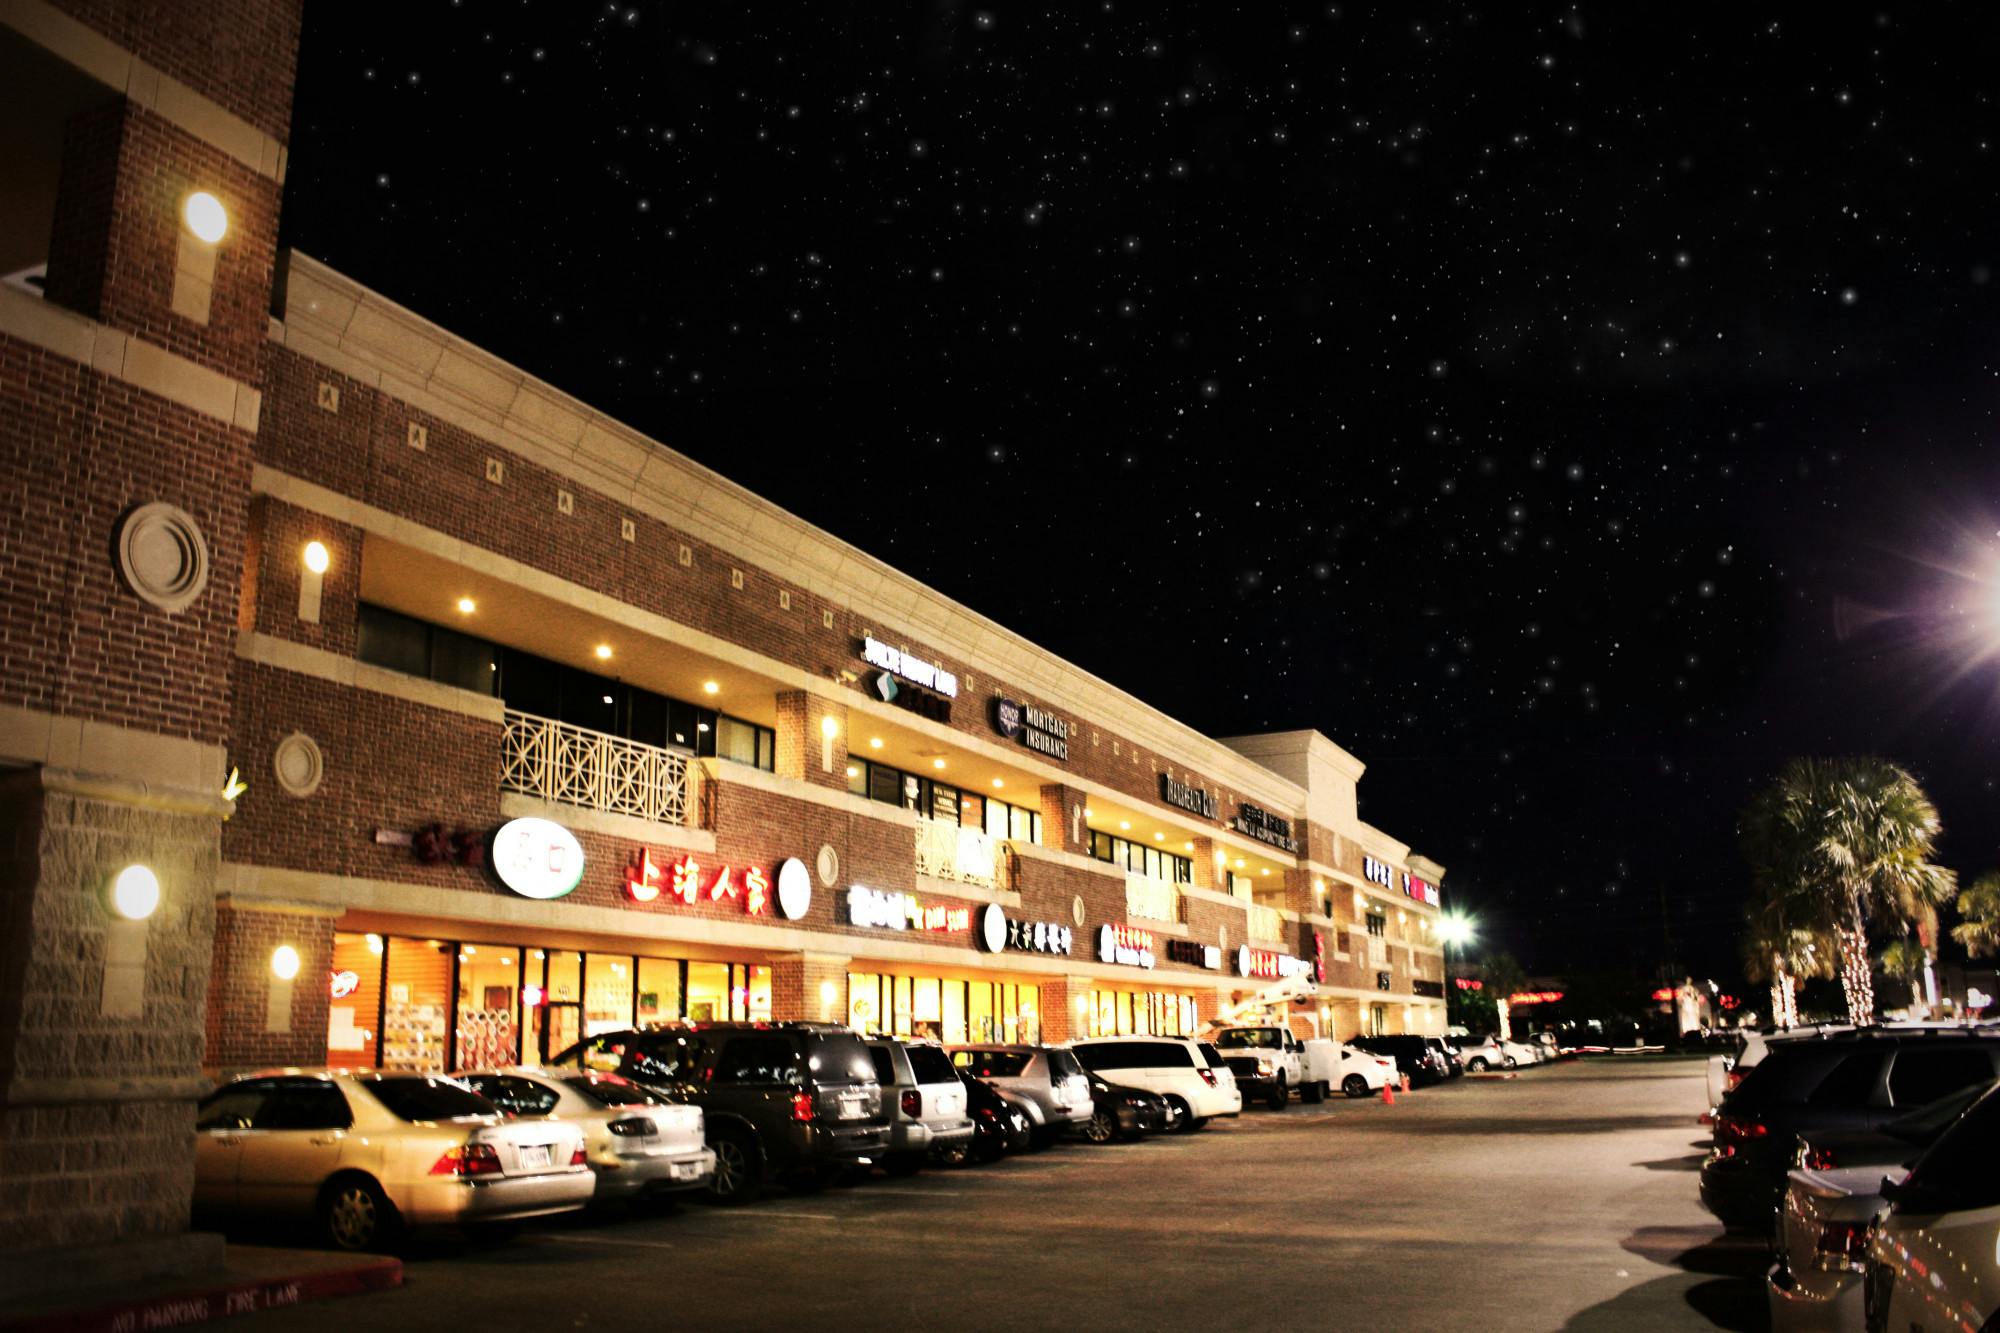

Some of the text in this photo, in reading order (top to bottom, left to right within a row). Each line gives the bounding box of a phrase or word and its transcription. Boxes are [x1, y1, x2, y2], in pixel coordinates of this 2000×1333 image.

[1025, 702, 1068, 740] MORTGAGE
[1026, 727, 1068, 761] INSURANCE
[630, 846, 769, 917] 上海人家
